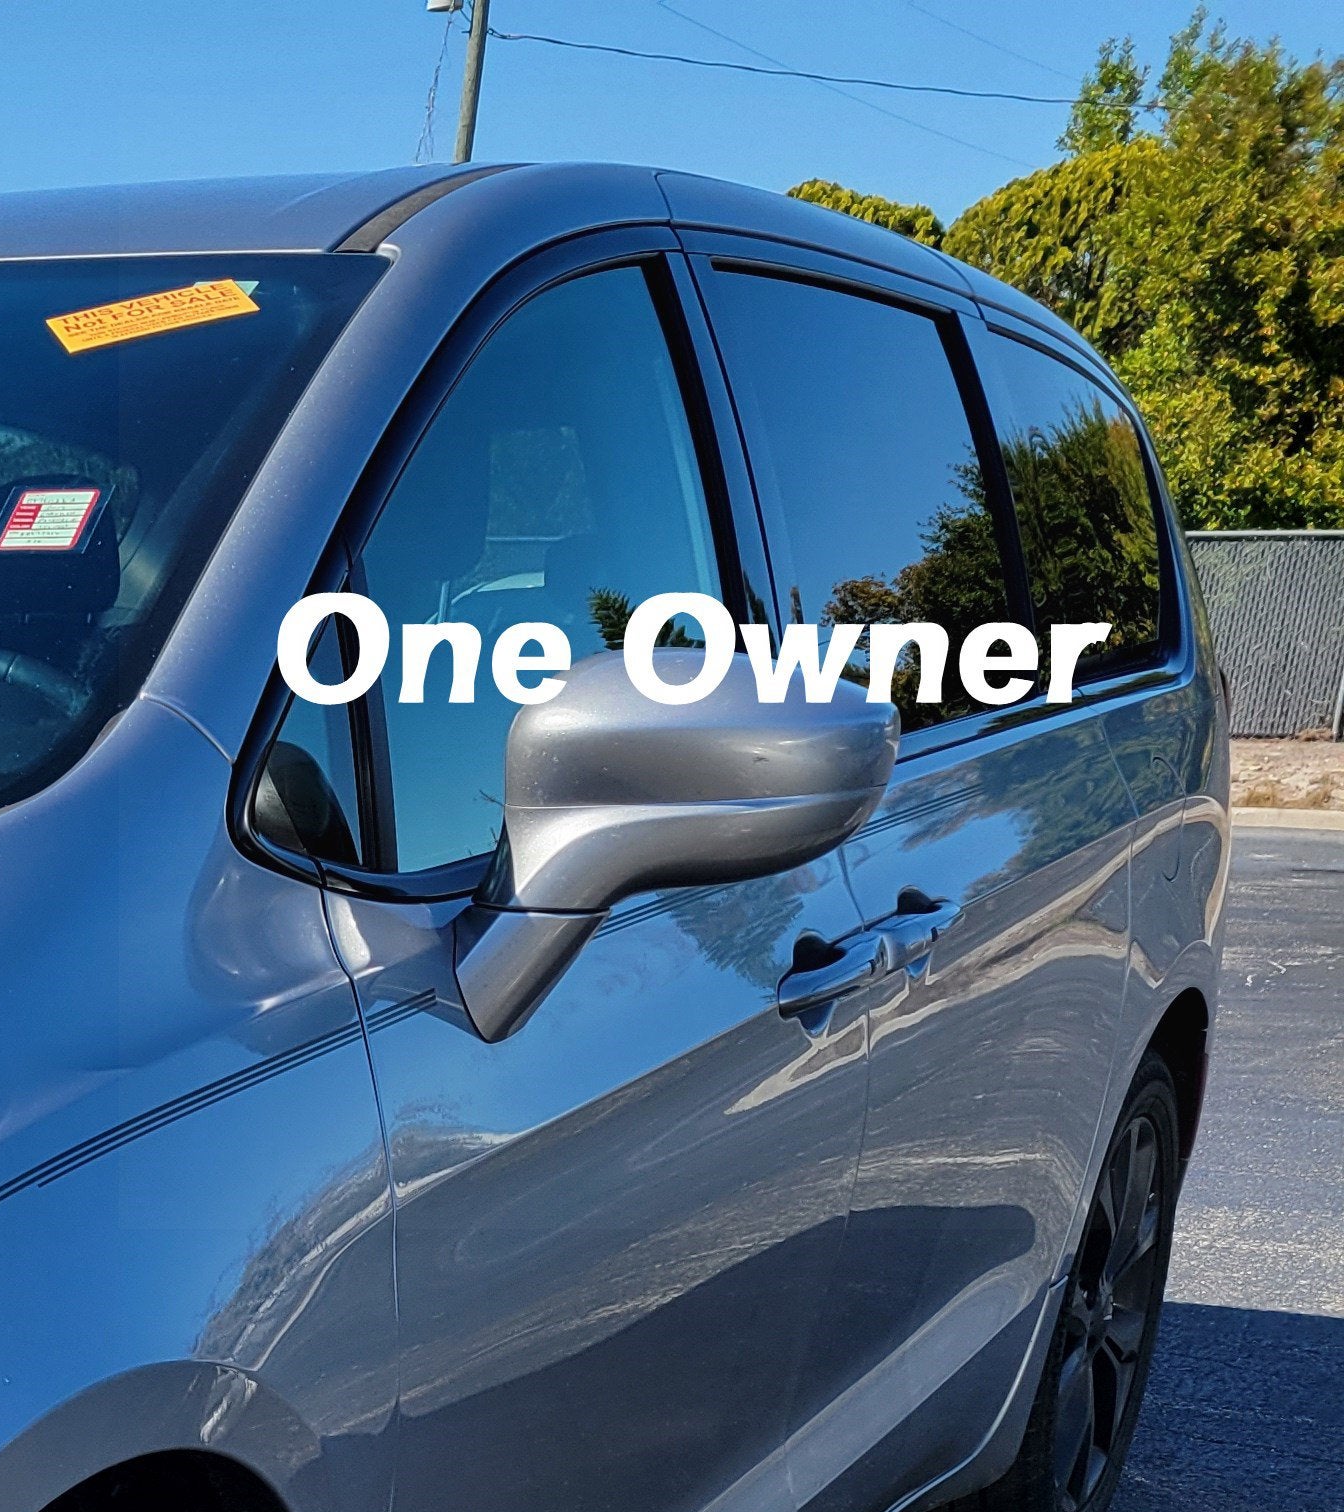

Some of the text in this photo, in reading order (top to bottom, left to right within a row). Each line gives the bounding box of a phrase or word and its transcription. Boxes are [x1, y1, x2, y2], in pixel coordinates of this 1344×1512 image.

[59, 307, 113, 325] THIS
[120, 283, 227, 309] VEHICLE
[112, 304, 165, 321] FOR
[176, 288, 236, 306] SALE
